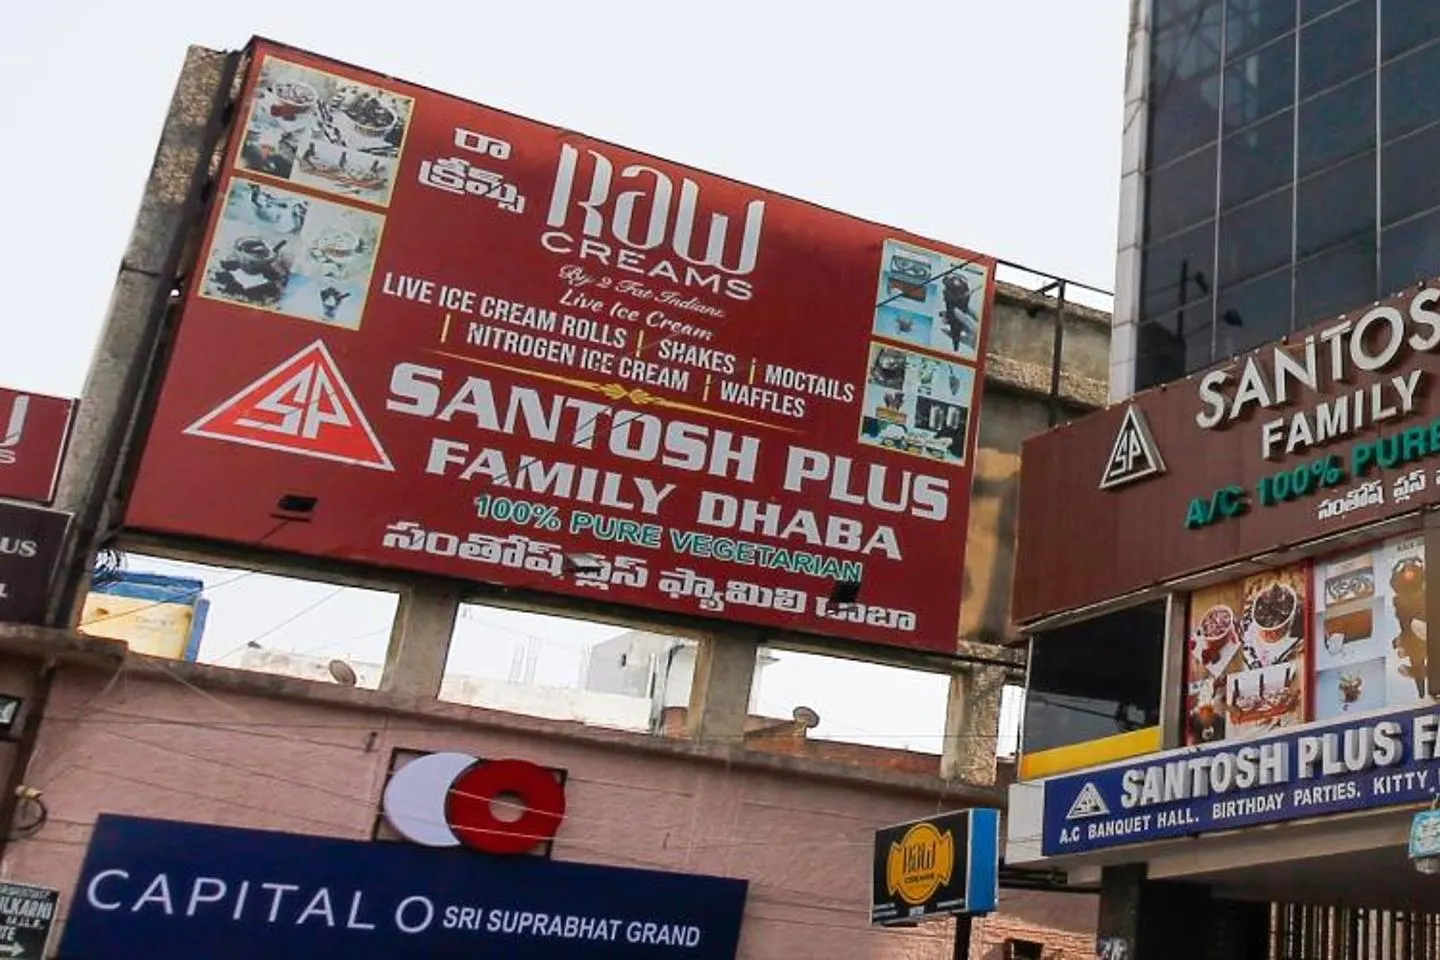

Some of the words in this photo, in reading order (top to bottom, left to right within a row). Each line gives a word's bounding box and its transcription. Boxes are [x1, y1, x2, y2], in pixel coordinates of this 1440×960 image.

[455, 127, 512, 160] రా
[540, 231, 753, 301] CREAMS
[382, 272, 433, 304] LIVE
[438, 284, 474, 314] ICE
[479, 293, 558, 333] CREAM
[561, 316, 628, 350] ROLLS
[657, 338, 736, 376] SHAKES
[764, 363, 856, 403] MOCTAILS
[559, 289, 604, 312] Live
[609, 302, 640, 322] Ice
[645, 310, 714, 341] Cream
[465, 322, 574, 367] NITROGEN
[581, 347, 614, 375] ICE
[618, 355, 690, 393] CREAM
[720, 382, 807, 419] WAFFLES
[386, 361, 762, 485] SANTOSH
[783, 444, 951, 522] PLUS
[1260, 370, 1422, 460] FAMILY
[424, 437, 677, 517] FAMILY
[696, 491, 904, 561] DHABA
[1184, 484, 1246, 529] A/C
[1256, 453, 1344, 507] 100%
[474, 493, 562, 531] 100%
[568, 511, 662, 548] PURE
[670, 528, 864, 584] VEGETARIAN
[1120, 742, 1290, 809] SANTOSH
[1298, 720, 1405, 779] PLUS
[1087, 814, 1151, 841] BANQUET
[1157, 807, 1200, 827] HALL.
[1211, 793, 1284, 819] BIRTHDAY
[1292, 780, 1361, 807] PARTIES.
[86, 867, 376, 931] CAPITAL
[394, 894, 434, 934] O
[442, 905, 483, 930] SRI
[486, 907, 625, 942] SUPRABHAT
[626, 919, 701, 948] GRAND
